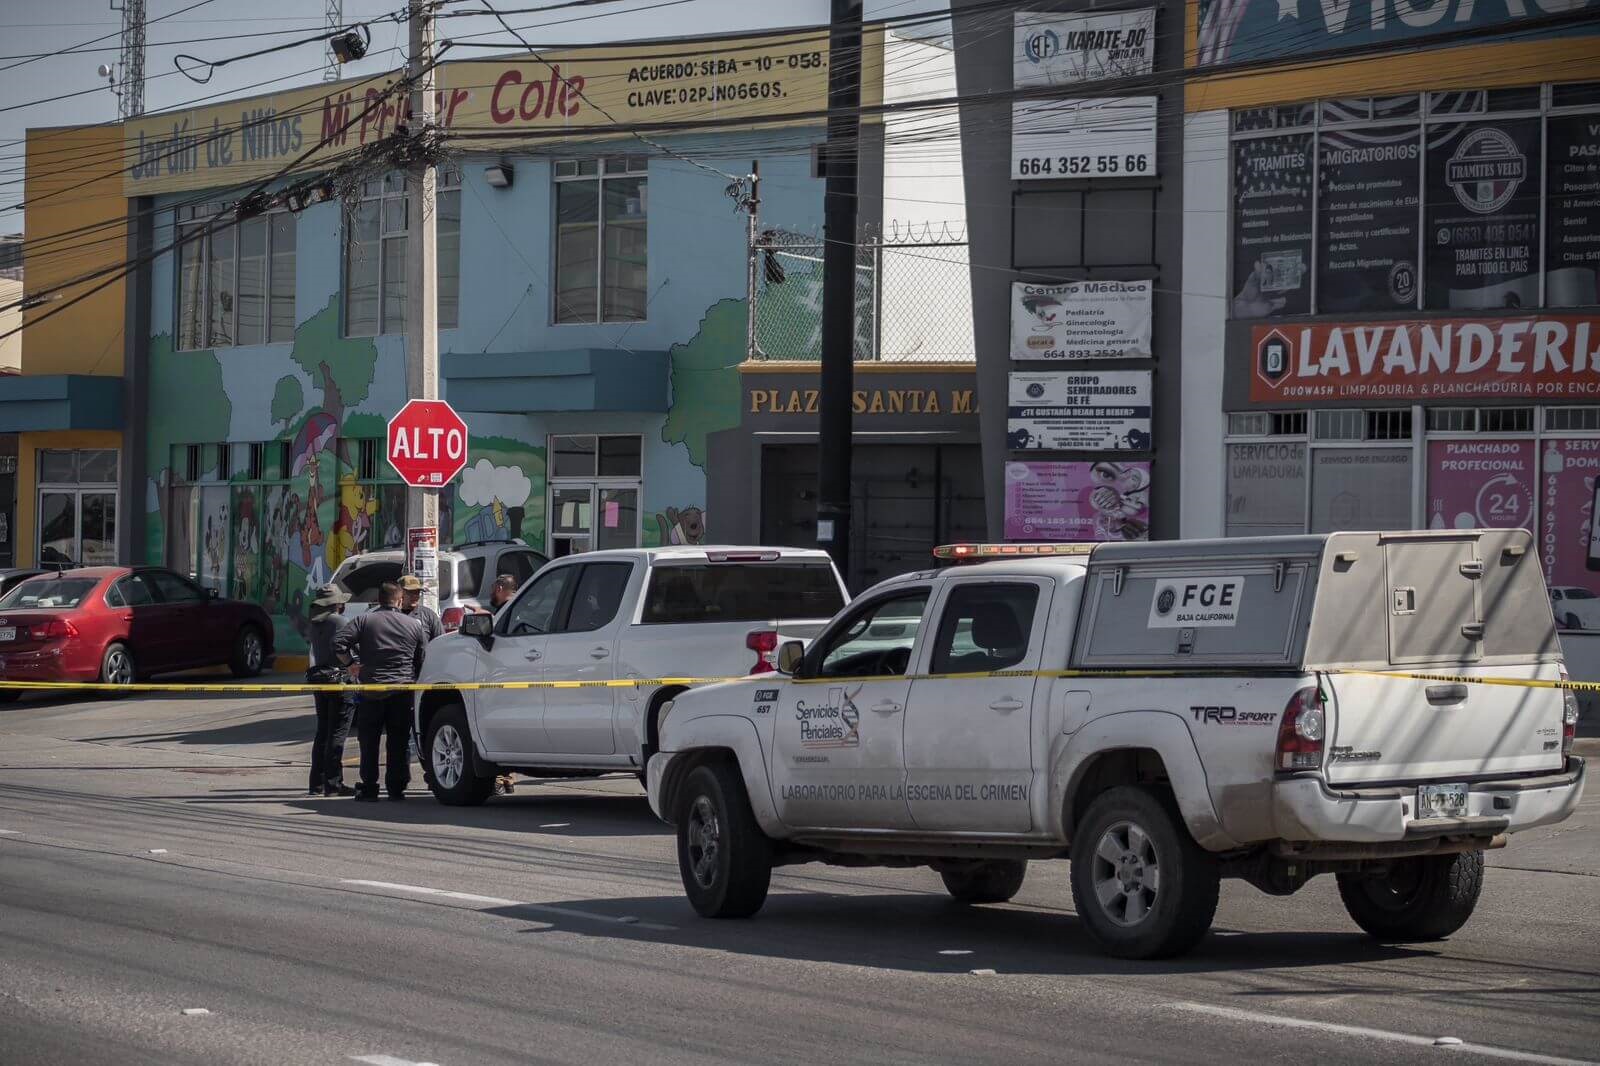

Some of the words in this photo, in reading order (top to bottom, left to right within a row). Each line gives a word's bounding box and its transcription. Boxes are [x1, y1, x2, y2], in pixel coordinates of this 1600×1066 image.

[1066, 28, 1147, 51] KARATE-DO
[206, 117, 233, 168] de
[320, 91, 353, 149] Mi
[359, 87, 469, 146] Prir
[491, 64, 585, 124] Cole
[1019, 157, 1051, 175] 664
[1058, 156, 1091, 174] 352
[1097, 155, 1119, 173] 55
[1125, 154, 1147, 172] 66
[1253, 153, 1305, 172] TRAMITES
[1326, 144, 1418, 166] MIGRATORIOS
[1451, 163, 1495, 179] TRAMITES
[1497, 161, 1522, 176] VELIS
[1495, 246, 1505, 258] EN
[1456, 263, 1476, 276] PARA
[1478, 261, 1498, 274] TODO
[1499, 261, 1509, 273] EL
[1396, 272, 1410, 288] 20
[1024, 285, 1079, 295] Centro
[1044, 350, 1065, 359] 664
[1069, 349, 1090, 358] 893
[1094, 349, 1124, 358] 2524
[1067, 376, 1099, 385] GRUPO
[1067, 386, 1137, 395] SEMBRADORES
[1340, 383, 1414, 396] LIMPIADURIA
[1420, 383, 1428, 394] &
[1433, 382, 1532, 394] PLANCHADURIA
[1537, 382, 1565, 393] POR
[750, 389, 821, 413] PLAZ
[852, 389, 940, 414] SANTA
[950, 389, 981, 414] M
[1067, 396, 1079, 405] DE
[391, 426, 463, 460] ALTO
[1447, 443, 1520, 455] PLANCHADO
[1565, 440, 1599, 450] SERV
[1233, 444, 1288, 461] SERVICIO
[1441, 459, 1525, 472] PROFECIONAL
[1566, 457, 1600, 468] DOM
[1233, 463, 1305, 480] LIMPIADURIA
[1489, 493, 1520, 514] 24
[1182, 583, 1236, 607] FGE
[1176, 614, 1194, 622] BAJA
[1195, 613, 1234, 621] CALIFORNIA
[757, 704, 771, 714] 657
[795, 700, 839, 721] Servicios
[1190, 706, 1237, 725] TRD
[1238, 712, 1277, 722] SPORT
[800, 720, 843, 740] Periciales
[781, 784, 856, 801] LABORATORIO
[858, 784, 883, 801] PARA
[885, 784, 903, 801] LA
[906, 784, 950, 801] ESCENA
[955, 784, 977, 801] DEL
[980, 784, 1027, 801] CRIMEN
